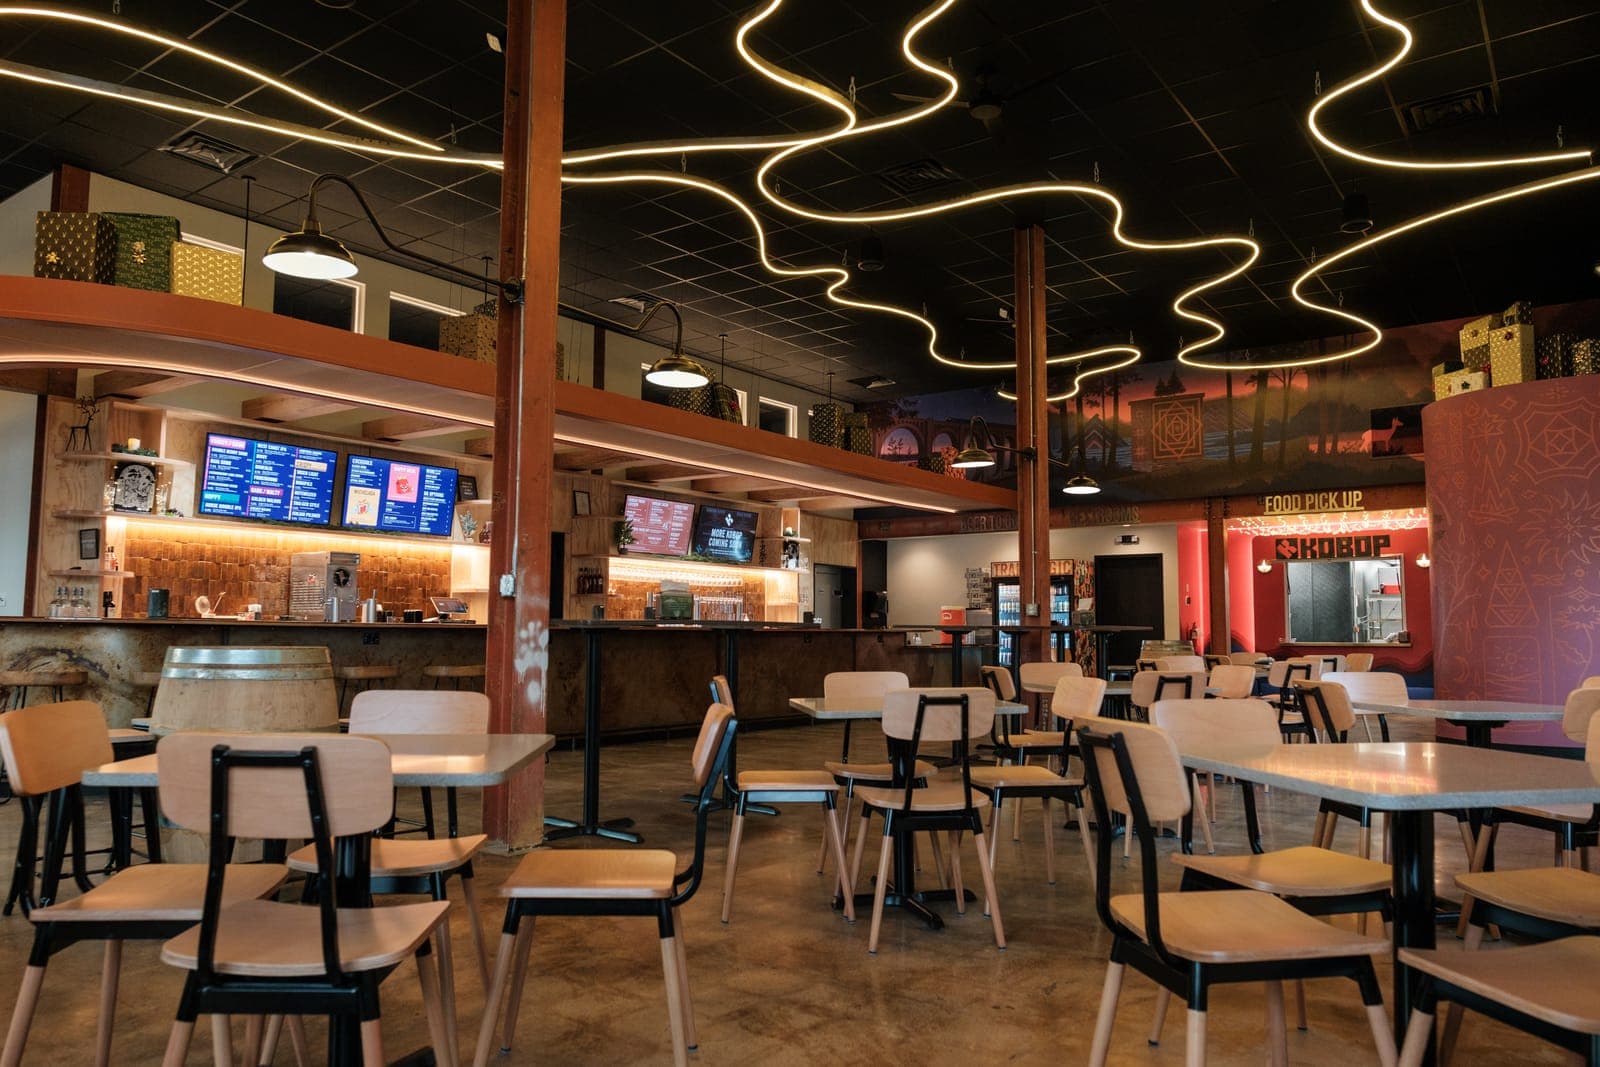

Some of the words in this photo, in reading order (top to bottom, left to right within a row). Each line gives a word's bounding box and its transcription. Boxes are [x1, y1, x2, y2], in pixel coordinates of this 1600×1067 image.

[1264, 494, 1301, 513] FOOD
[1305, 491, 1339, 511] PICK
[1342, 490, 1363, 508] UP
[711, 528, 727, 539] MORE
[1299, 535, 1391, 559] KOBOP
